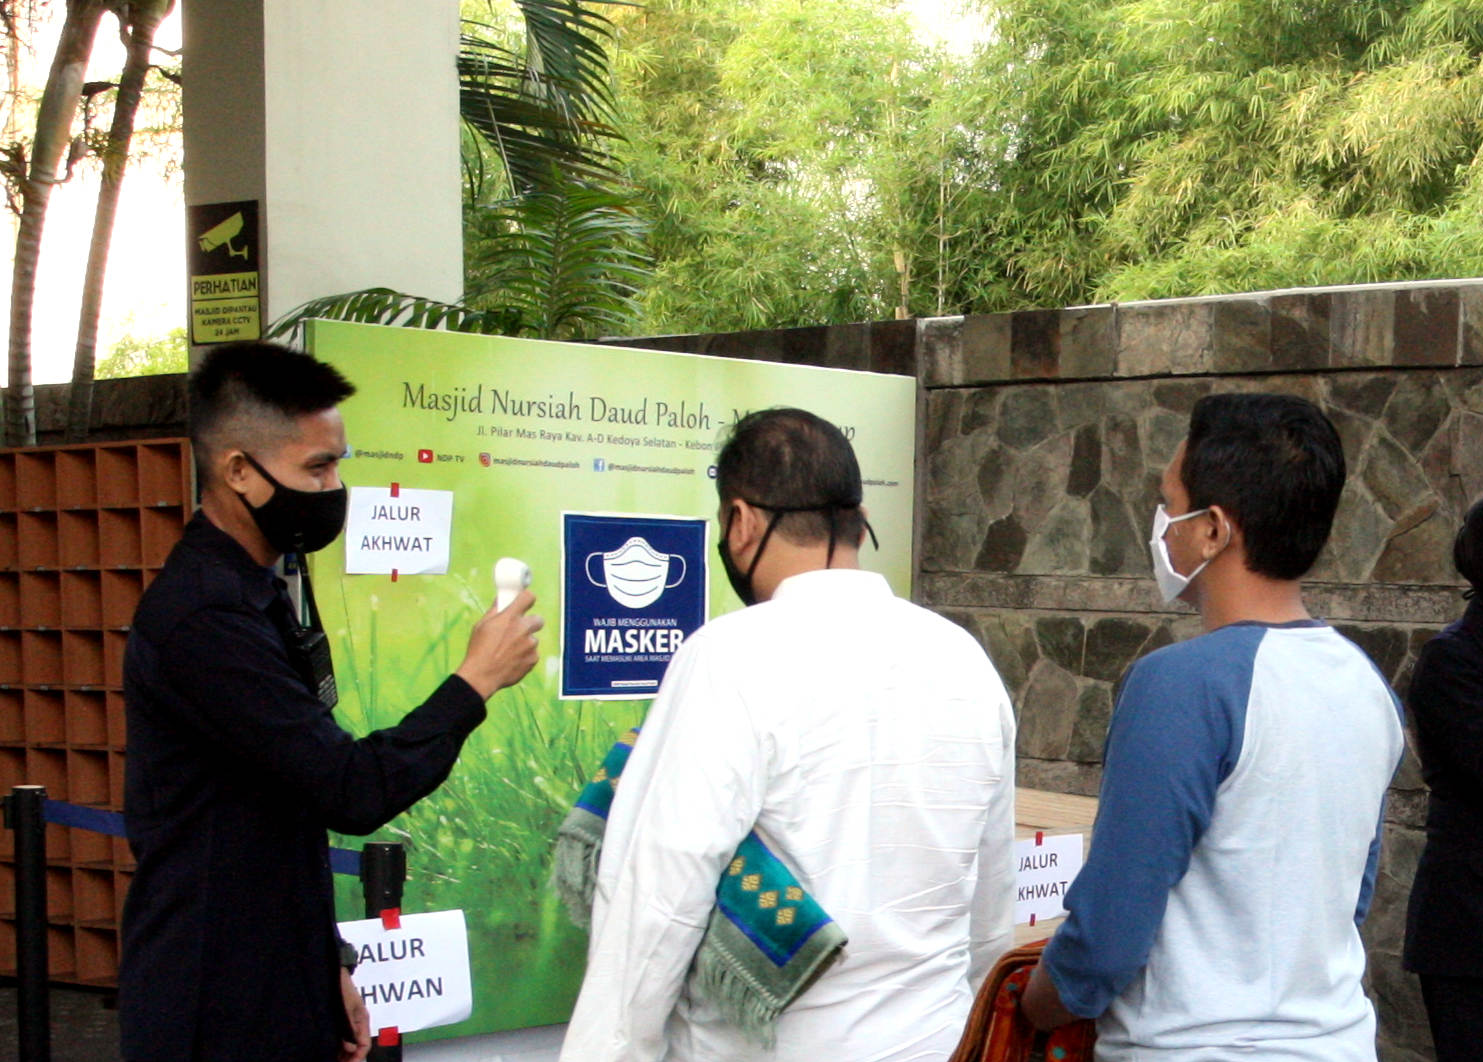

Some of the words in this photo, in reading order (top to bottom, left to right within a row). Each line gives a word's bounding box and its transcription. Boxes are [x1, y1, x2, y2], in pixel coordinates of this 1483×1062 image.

[194, 277, 256, 295] PERHATIAN
[195, 306, 221, 315] MASJID
[203, 317, 231, 326] KAMERA
[234, 315, 251, 324] CCTV
[226, 327, 240, 336] JAM
[402, 381, 483, 422] Masjid
[491, 389, 582, 421] Nursiah
[590, 396, 648, 426] Daud
[656, 400, 710, 430] Paloh
[490, 426, 513, 438] Pilar
[516, 428, 537, 439] Mas
[539, 429, 562, 442] Raya
[565, 432, 584, 442] Kav.
[586, 433, 604, 444] A-D
[607, 434, 640, 446] Kedoya
[642, 437, 677, 448] Selatan
[685, 441, 713, 450] Kebon
[371, 504, 421, 521] JALUR
[360, 535, 433, 552] AKHWAT
[593, 618, 616, 627] WAJIB
[618, 618, 677, 627] MENGGUNAKAN
[584, 628, 684, 654] MASKER
[1018, 853, 1058, 872] JALUR
[1017, 881, 1068, 901] KHWAT
[358, 937, 425, 965] ALUR
[361, 977, 443, 1004] HWAN
